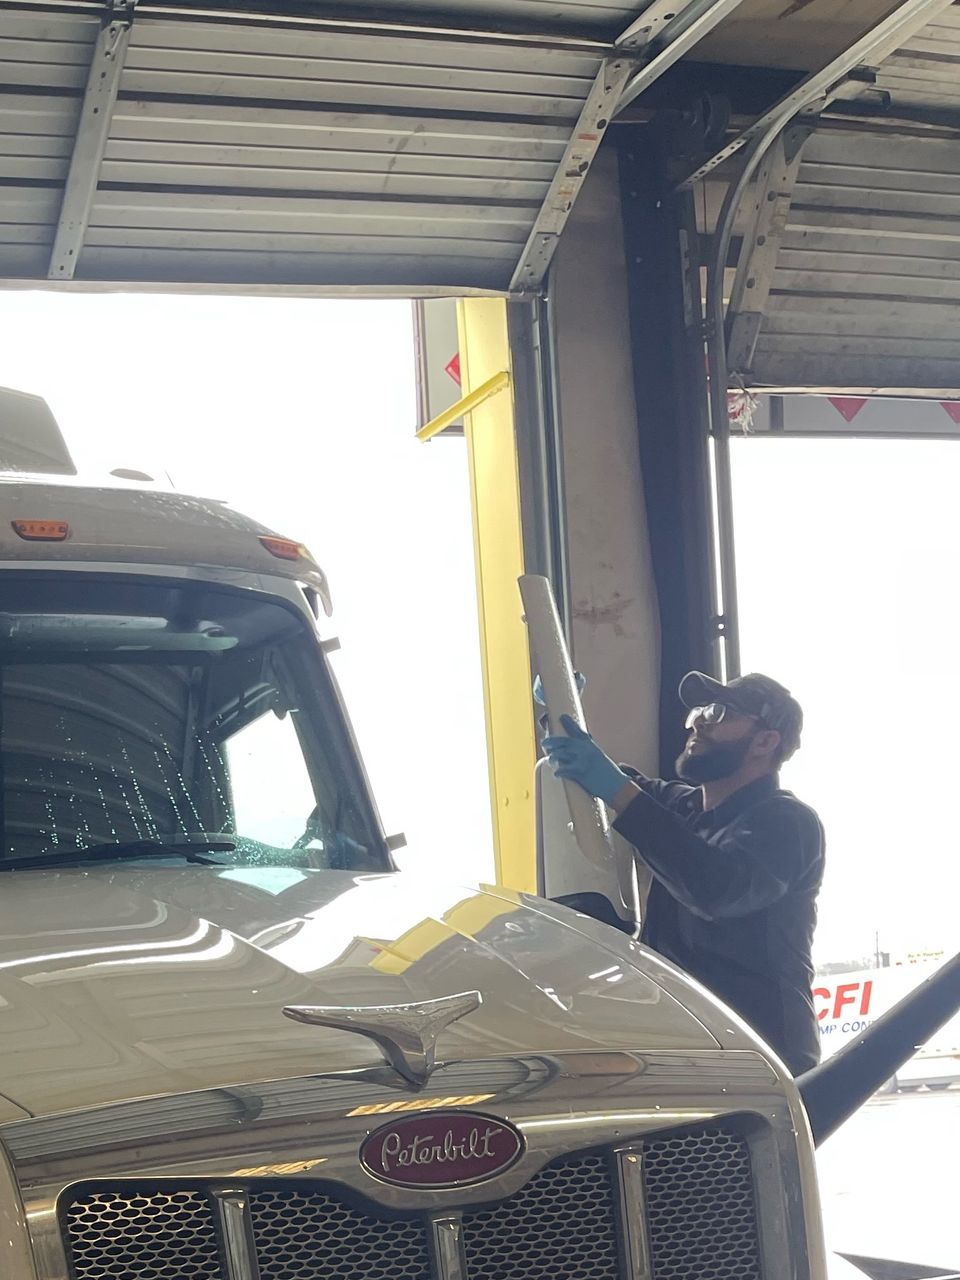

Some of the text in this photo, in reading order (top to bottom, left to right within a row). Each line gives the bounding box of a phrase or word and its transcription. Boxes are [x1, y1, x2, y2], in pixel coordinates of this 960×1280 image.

[811, 980, 873, 1021] CFI
[819, 1020, 872, 1035] MP CON
[381, 1127, 503, 1173] Peterbilt
